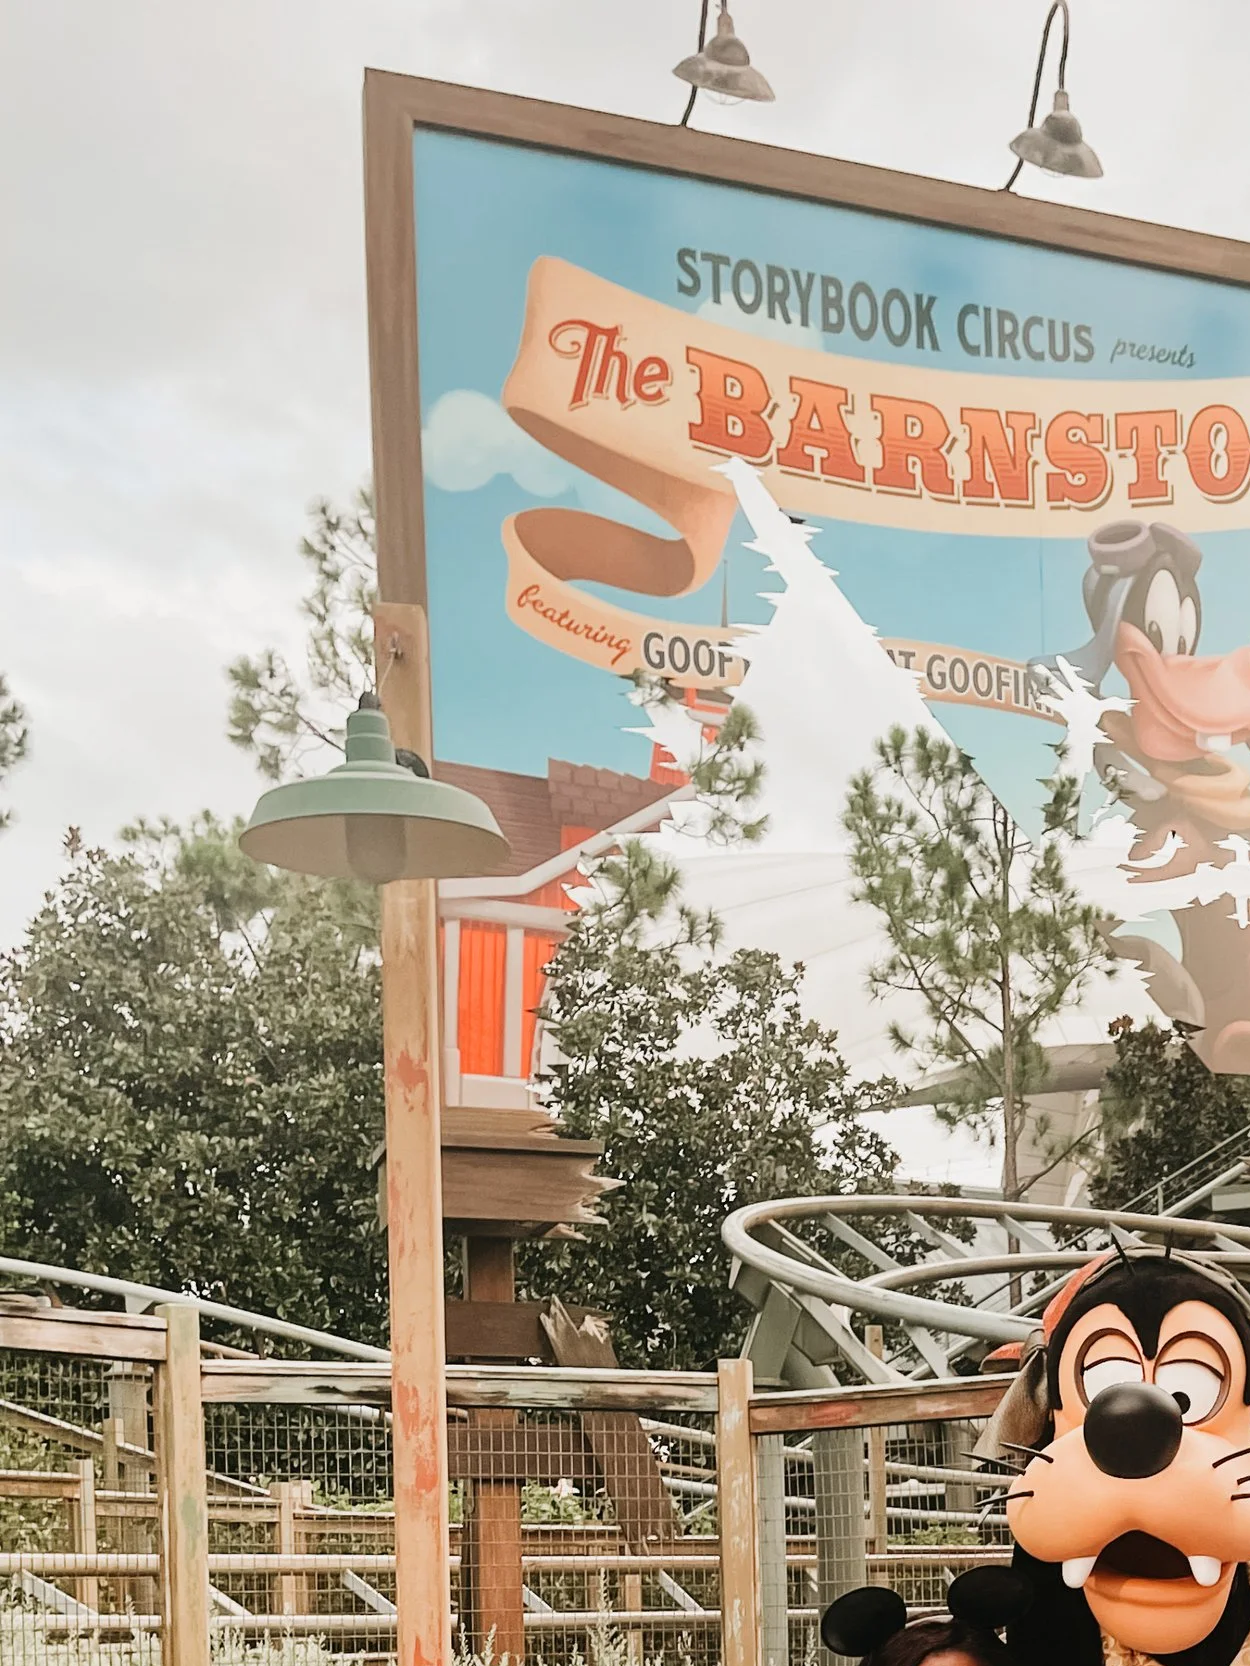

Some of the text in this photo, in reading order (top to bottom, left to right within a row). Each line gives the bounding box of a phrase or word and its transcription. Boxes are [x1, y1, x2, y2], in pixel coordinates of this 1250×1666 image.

[676, 247, 1197, 369] STORYBOOK CIRCUS presents
[548, 319, 672, 410] The
[517, 584, 631, 666] featuring
